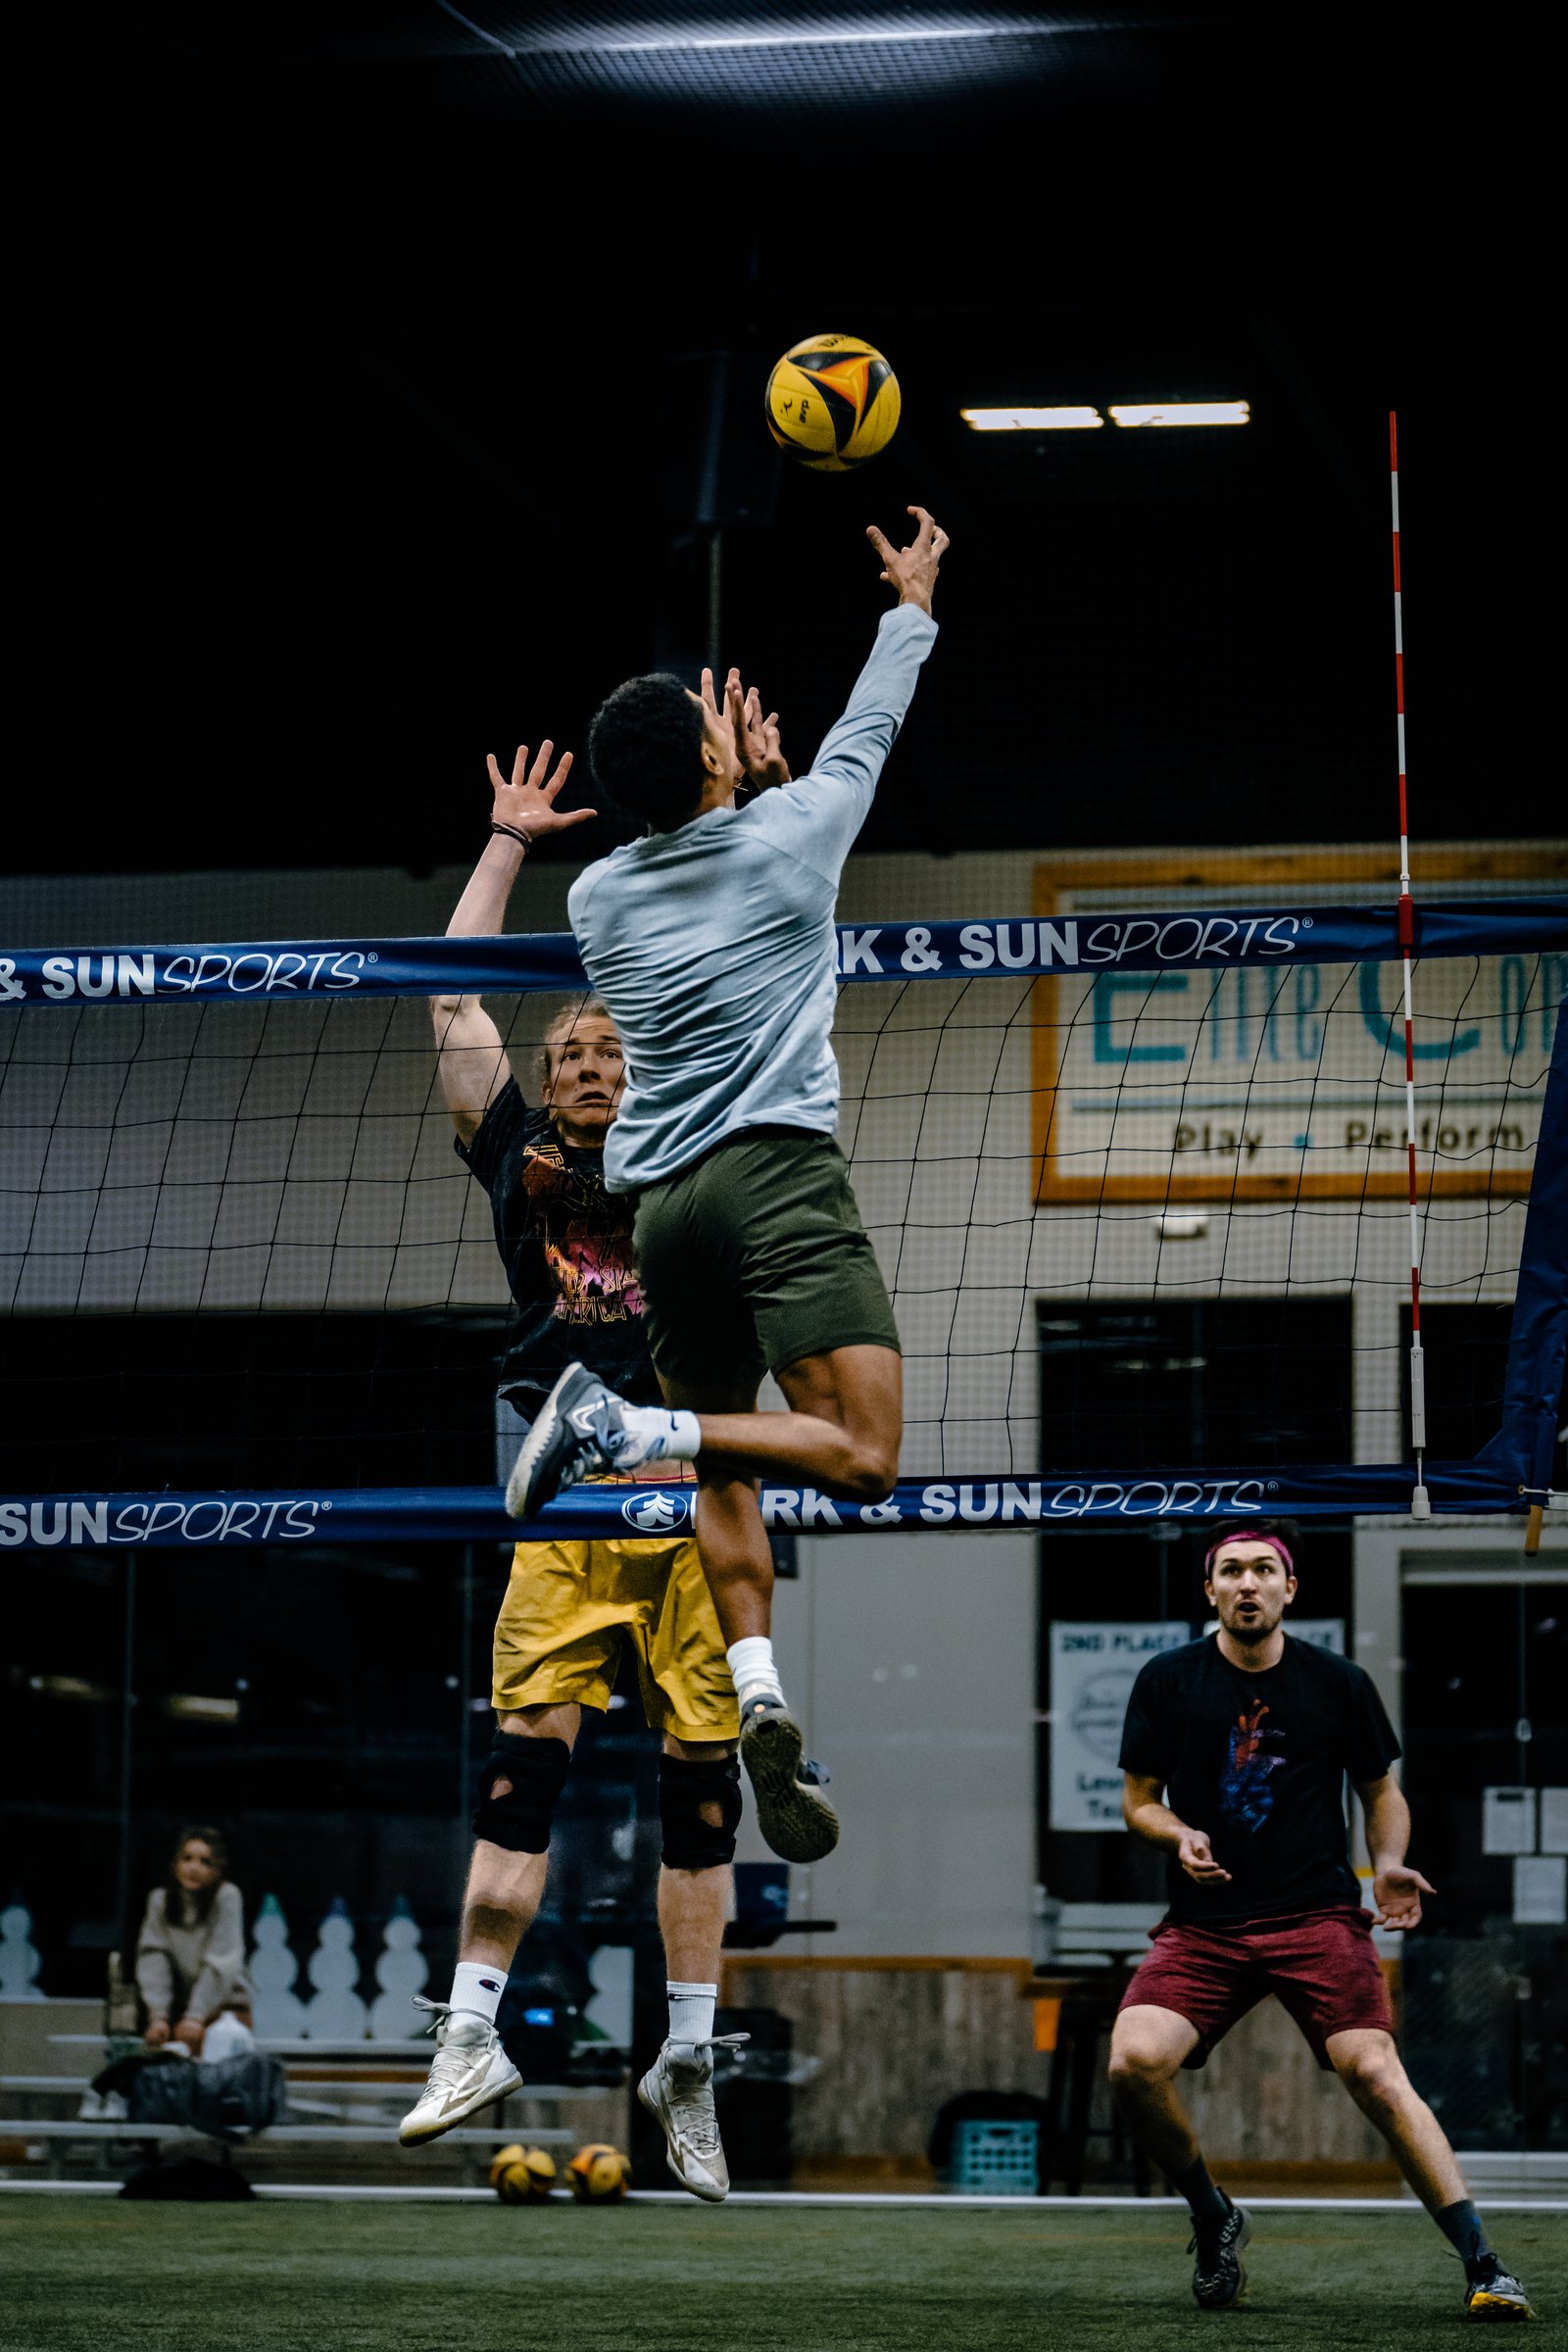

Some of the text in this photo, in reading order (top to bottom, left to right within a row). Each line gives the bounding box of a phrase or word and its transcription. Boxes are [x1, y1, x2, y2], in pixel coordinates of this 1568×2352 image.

[901, 926, 944, 972] &
[958, 920, 1079, 970] SUN
[41, 954, 156, 999] SUN
[1173, 1121, 1264, 1161] Play
[920, 1482, 1042, 1523] SUN
